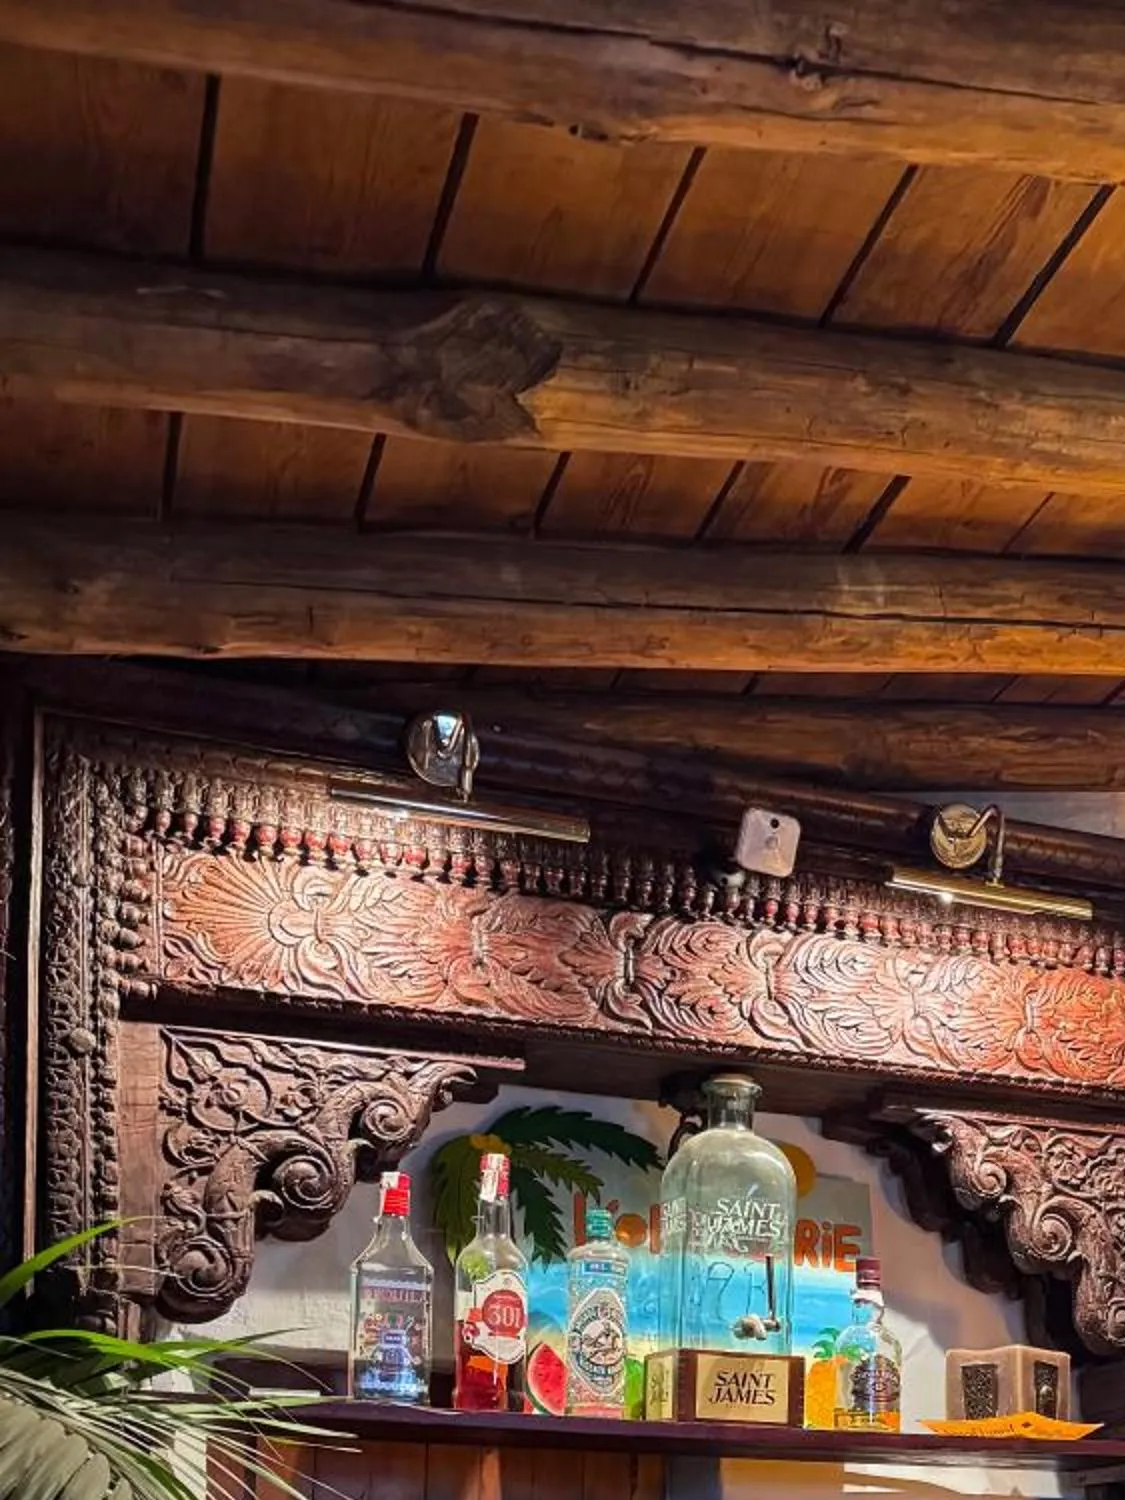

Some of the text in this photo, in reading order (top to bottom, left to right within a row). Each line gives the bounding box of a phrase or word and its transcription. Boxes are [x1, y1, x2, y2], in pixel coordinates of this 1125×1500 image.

[487, 1303, 523, 1327] 301
[714, 1370, 774, 1389] SAINT
[709, 1388, 777, 1406] JAMES
